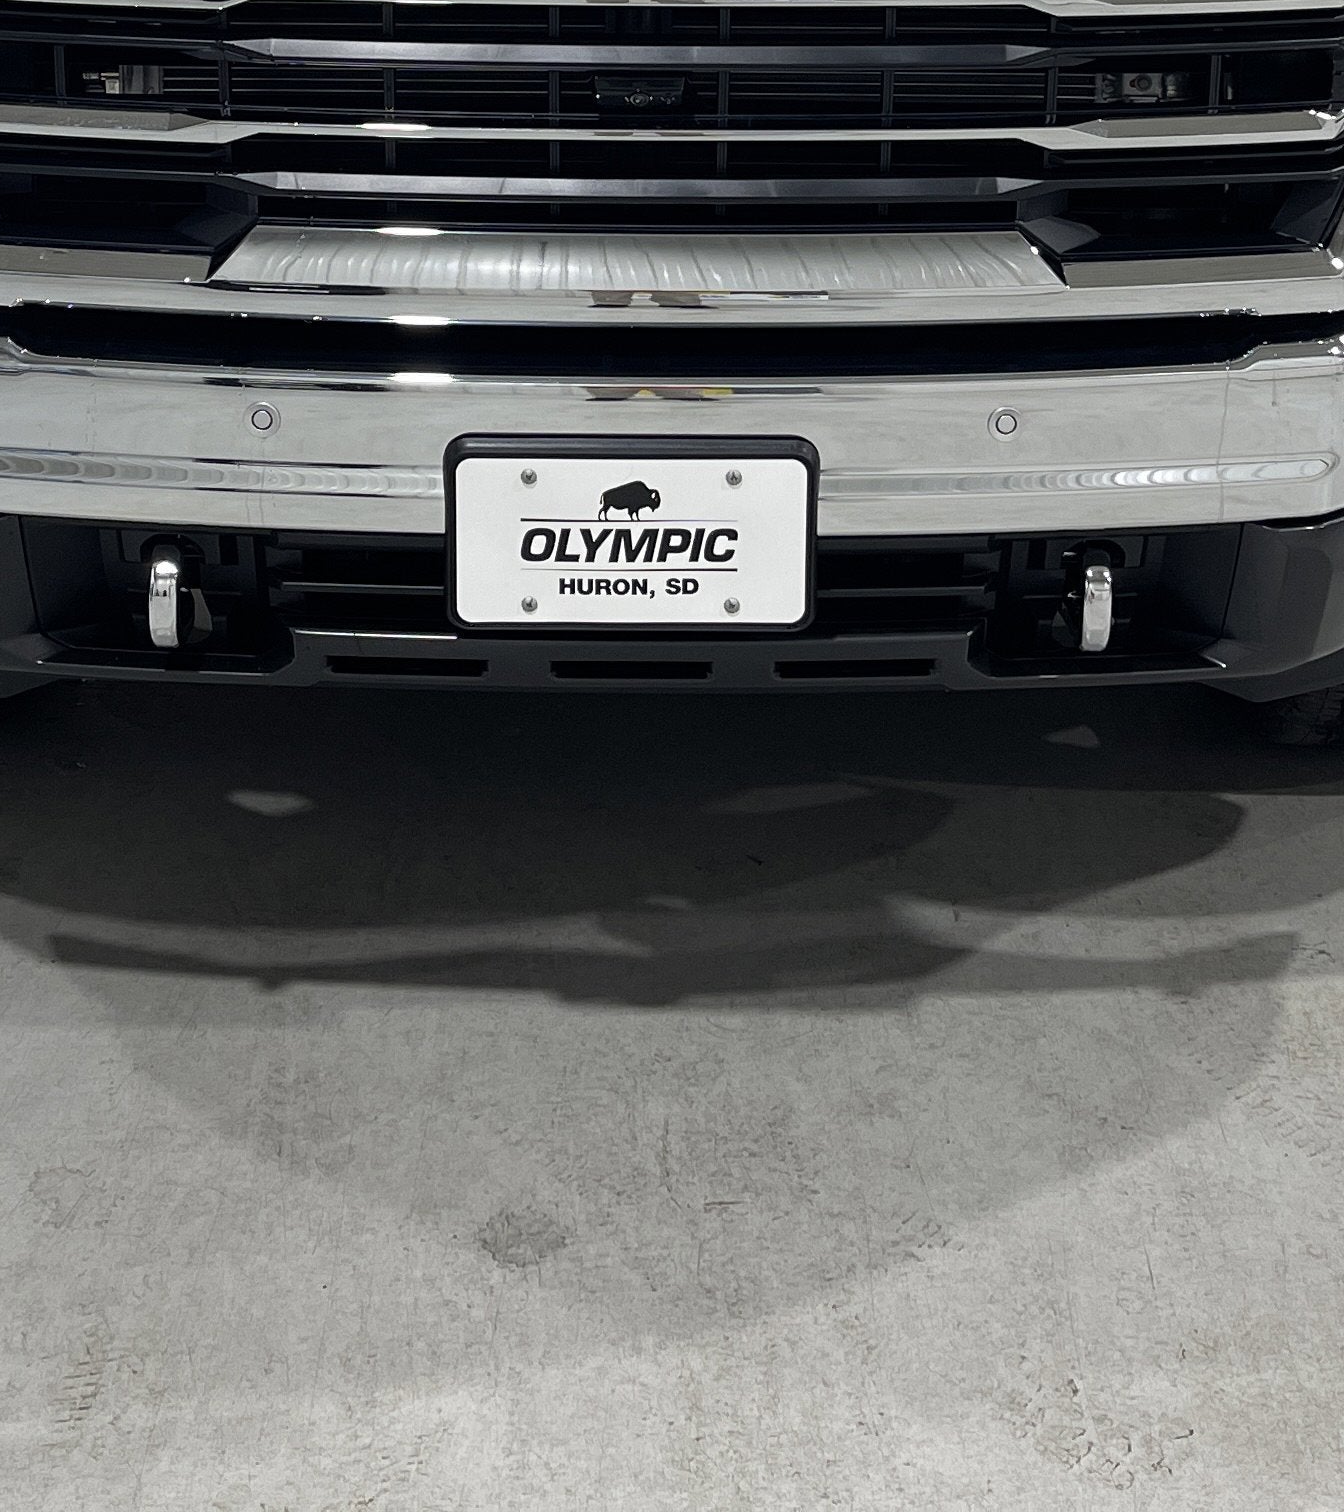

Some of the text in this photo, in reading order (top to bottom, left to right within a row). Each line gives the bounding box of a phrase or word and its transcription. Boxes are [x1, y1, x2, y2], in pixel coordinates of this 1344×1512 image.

[520, 527, 739, 563] OLYMPIC
[558, 577, 699, 599] HURON, SD
